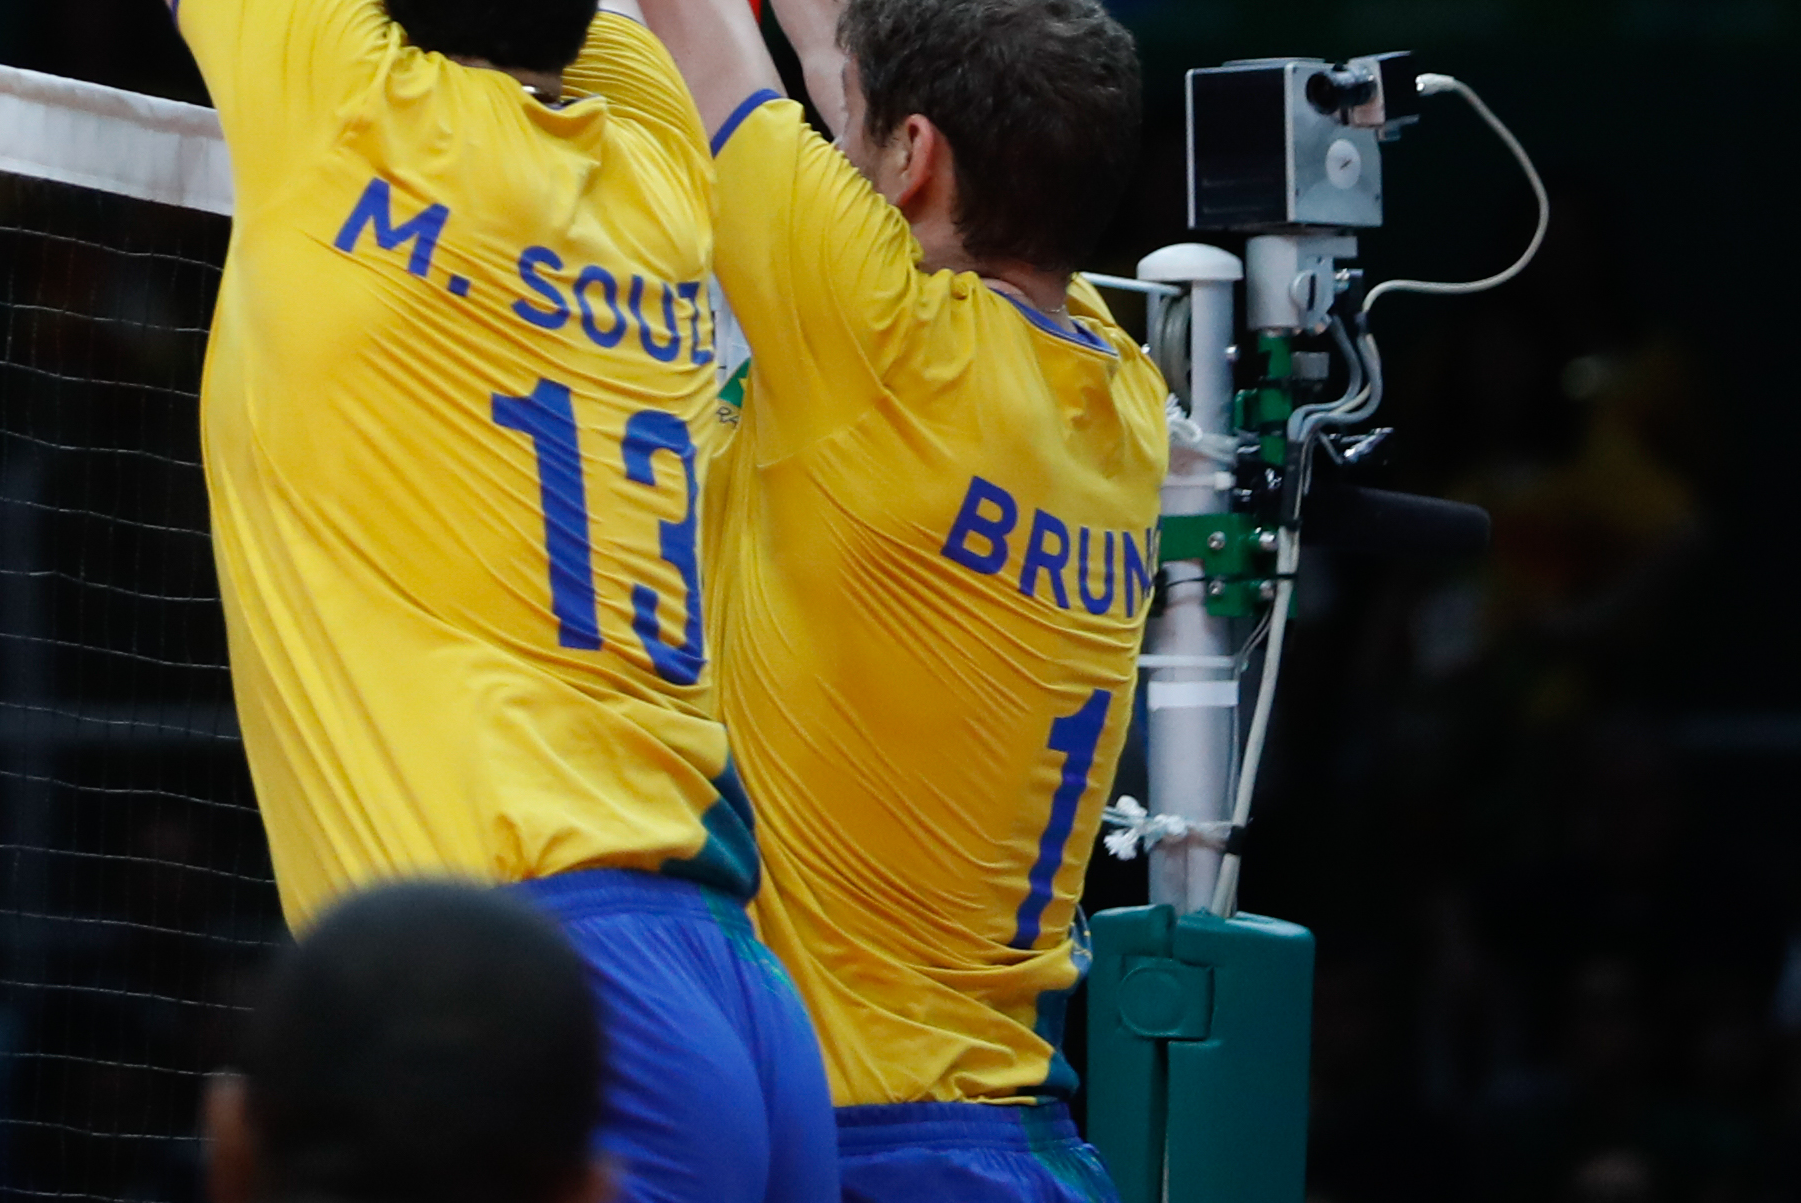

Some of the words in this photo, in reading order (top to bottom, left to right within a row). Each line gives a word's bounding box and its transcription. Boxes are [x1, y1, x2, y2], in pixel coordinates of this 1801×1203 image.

[334, 177, 471, 297] M.
[491, 377, 707, 686] 13
[942, 475, 1161, 619] BRUN
[1008, 688, 1112, 950] 1
